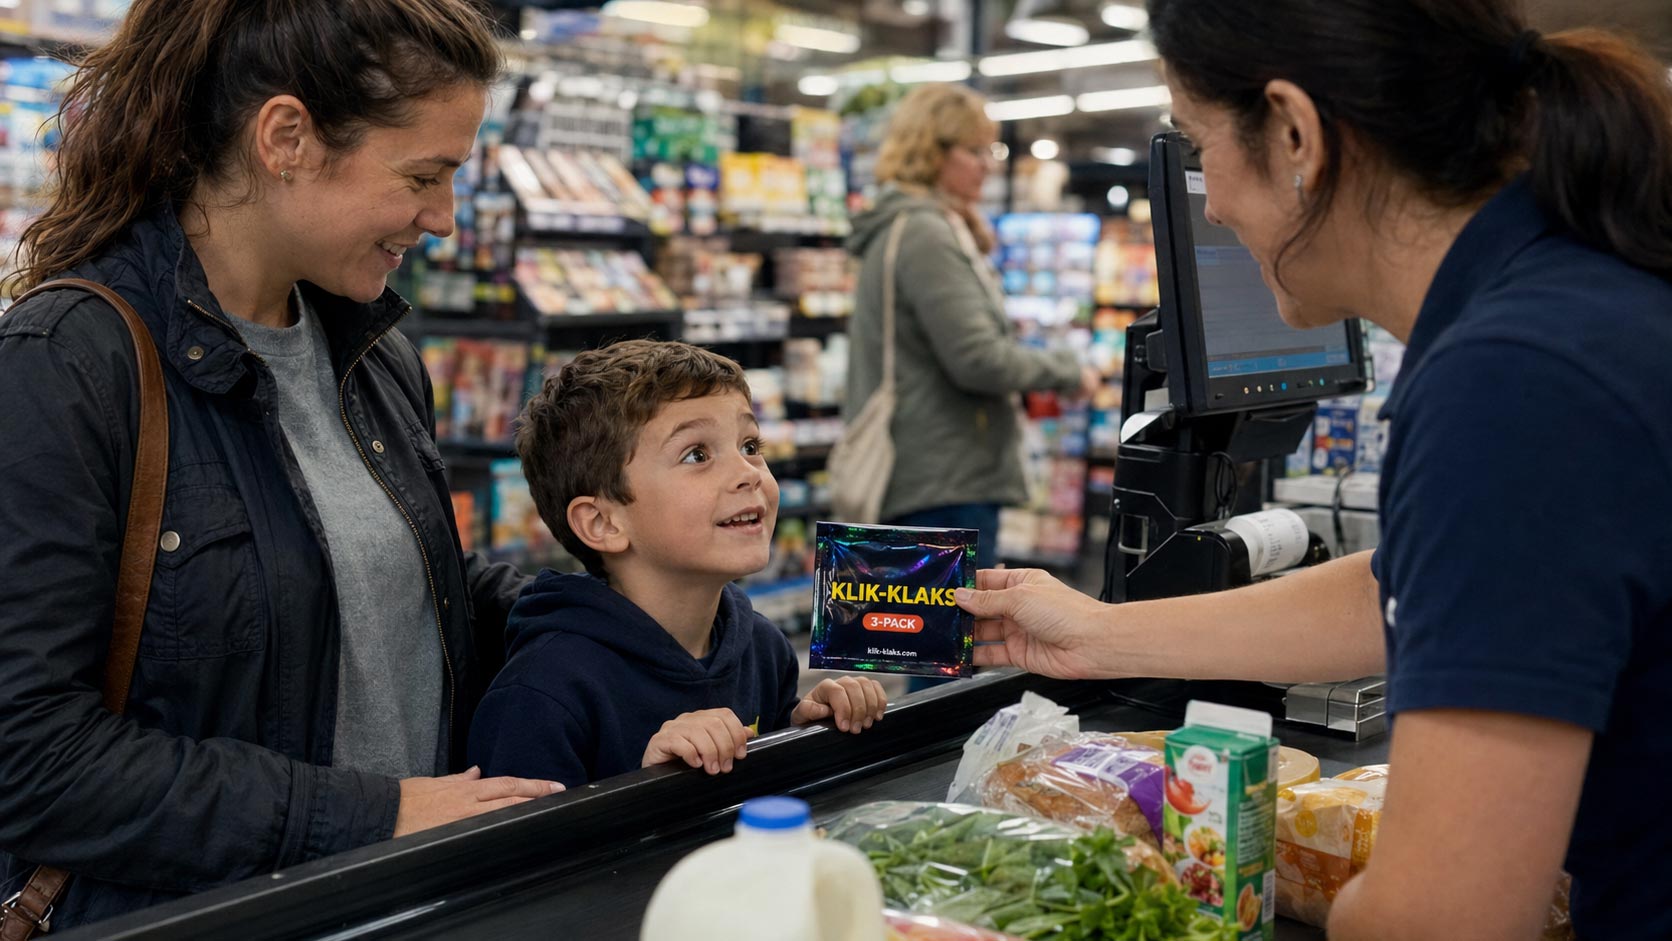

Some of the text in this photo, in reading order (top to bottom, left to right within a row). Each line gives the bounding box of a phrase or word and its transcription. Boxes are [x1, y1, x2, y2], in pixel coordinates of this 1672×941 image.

[831, 581, 957, 607] KLIK-KLAKS
[871, 617, 916, 630] 3-PACK
[867, 647, 917, 657] klik-klaks.com
